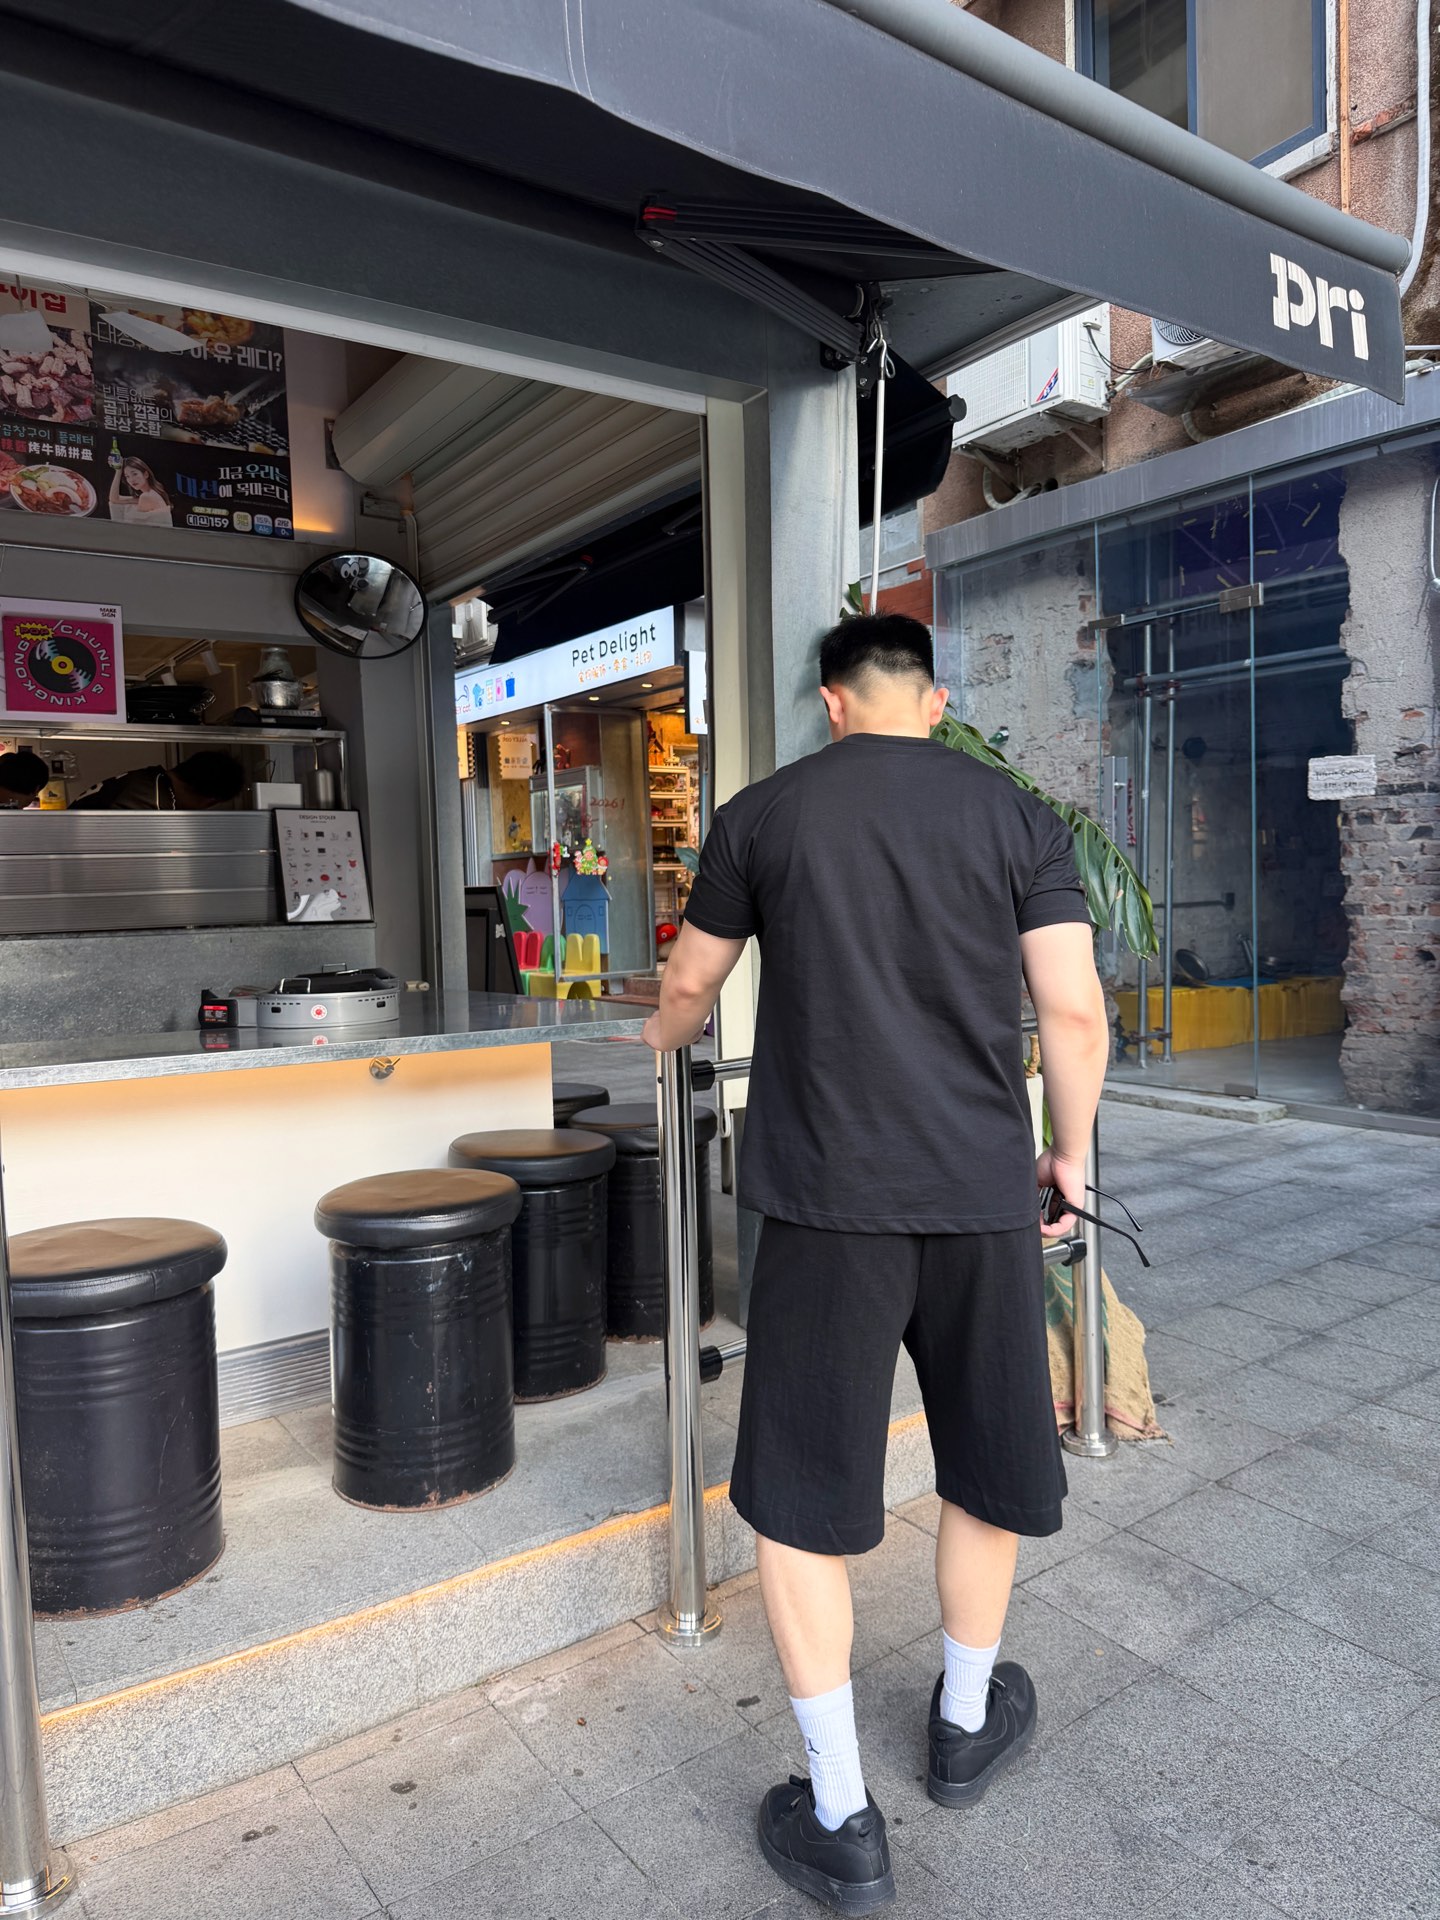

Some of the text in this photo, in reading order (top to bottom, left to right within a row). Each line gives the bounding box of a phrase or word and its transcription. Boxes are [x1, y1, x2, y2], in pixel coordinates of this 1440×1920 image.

[1269, 252, 1369, 361] pri
[103, 415, 162, 437] 환상 조합
[60, 625, 111, 678] CHUNLI
[572, 622, 656, 668] Pet Delight
